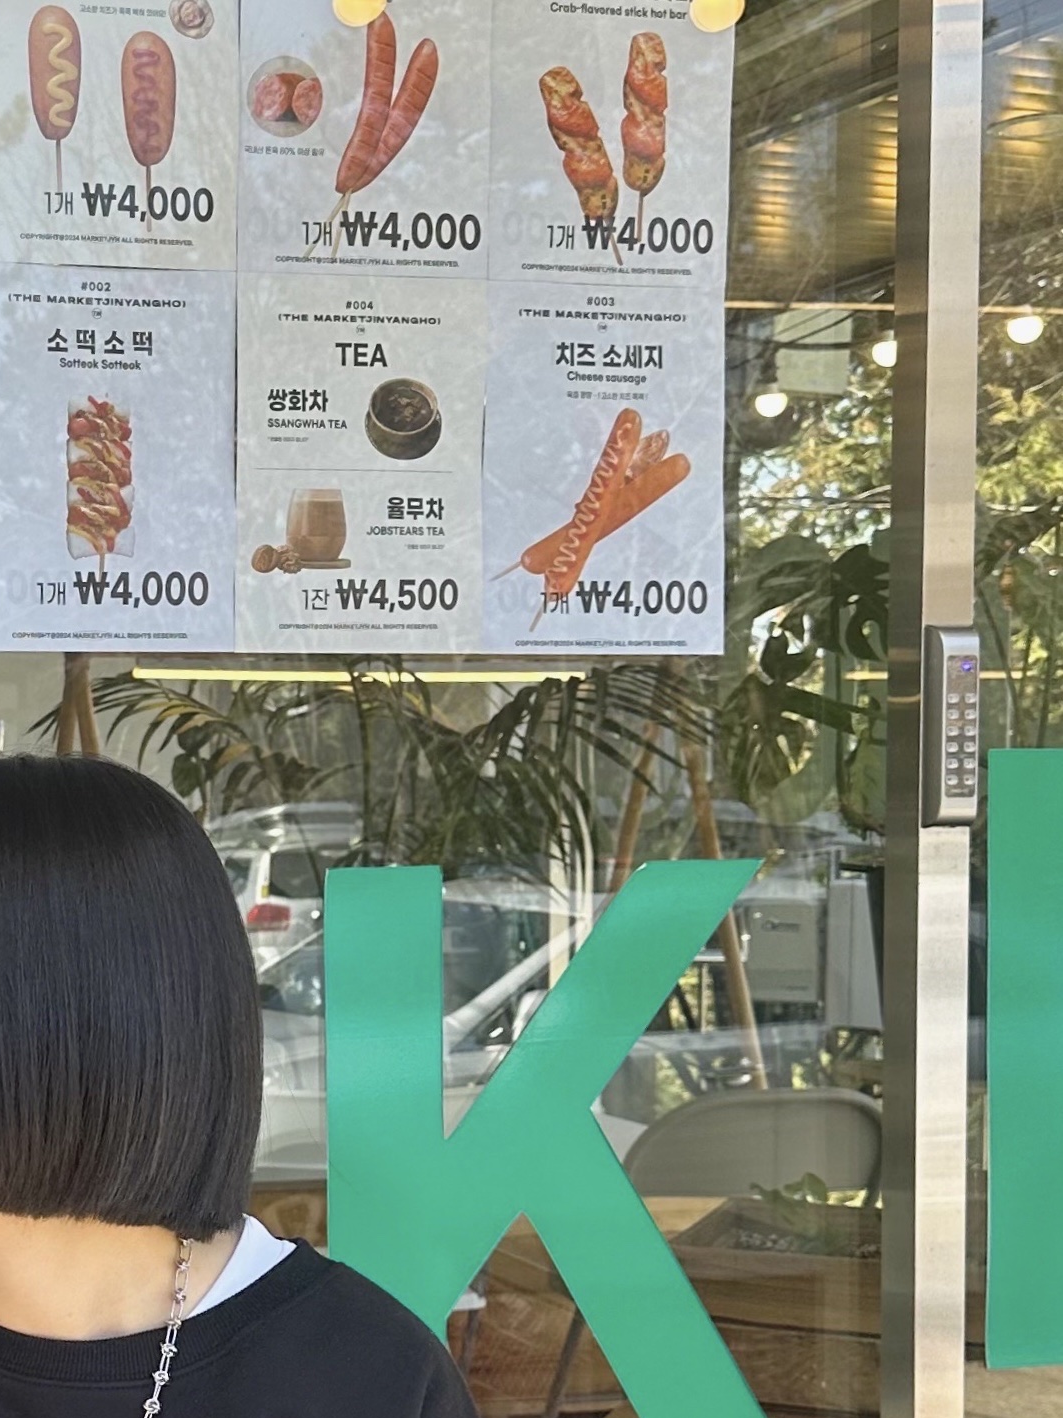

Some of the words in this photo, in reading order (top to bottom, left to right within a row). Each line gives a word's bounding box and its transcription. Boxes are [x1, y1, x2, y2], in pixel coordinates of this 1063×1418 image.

[550, 2, 622, 16] Crab-flavored
[625, 6, 648, 17] stick
[650, 8, 667, 19] hot
[669, 9, 687, 20] bar
[44, 192, 74, 216] 1개
[81, 182, 214, 223] ₩4,000
[302, 221, 333, 246] 1개
[340, 210, 481, 251] ₩4,000
[547, 225, 575, 250] 1개
[581, 215, 713, 254] ₩4,000
[81, 282, 112, 292] #002
[345, 301, 374, 310] #004
[586, 297, 615, 307] #003
[59, 357, 99, 370] Sotteok
[101, 359, 141, 370] Sotteok
[335, 342, 388, 367] TEA
[555, 342, 596, 367] 치즈
[602, 345, 663, 369] 소세지
[567, 371, 603, 382] Cheese
[605, 374, 647, 385] sausage
[267, 388, 329, 413] 쌍화차
[267, 418, 326, 429] SSANGWHA
[328, 419, 347, 429] TEA
[387, 497, 444, 521] 율무차
[366, 526, 424, 536] JOBSTEARS
[426, 527, 445, 536] TEA
[37, 581, 66, 605] 1개
[73, 570, 209, 609] ₩4,000
[301, 588, 330, 610] 1잔
[335, 578, 458, 613] ₩4,500
[540, 592, 570, 614] 1개
[575, 580, 708, 617] ₩4,000
